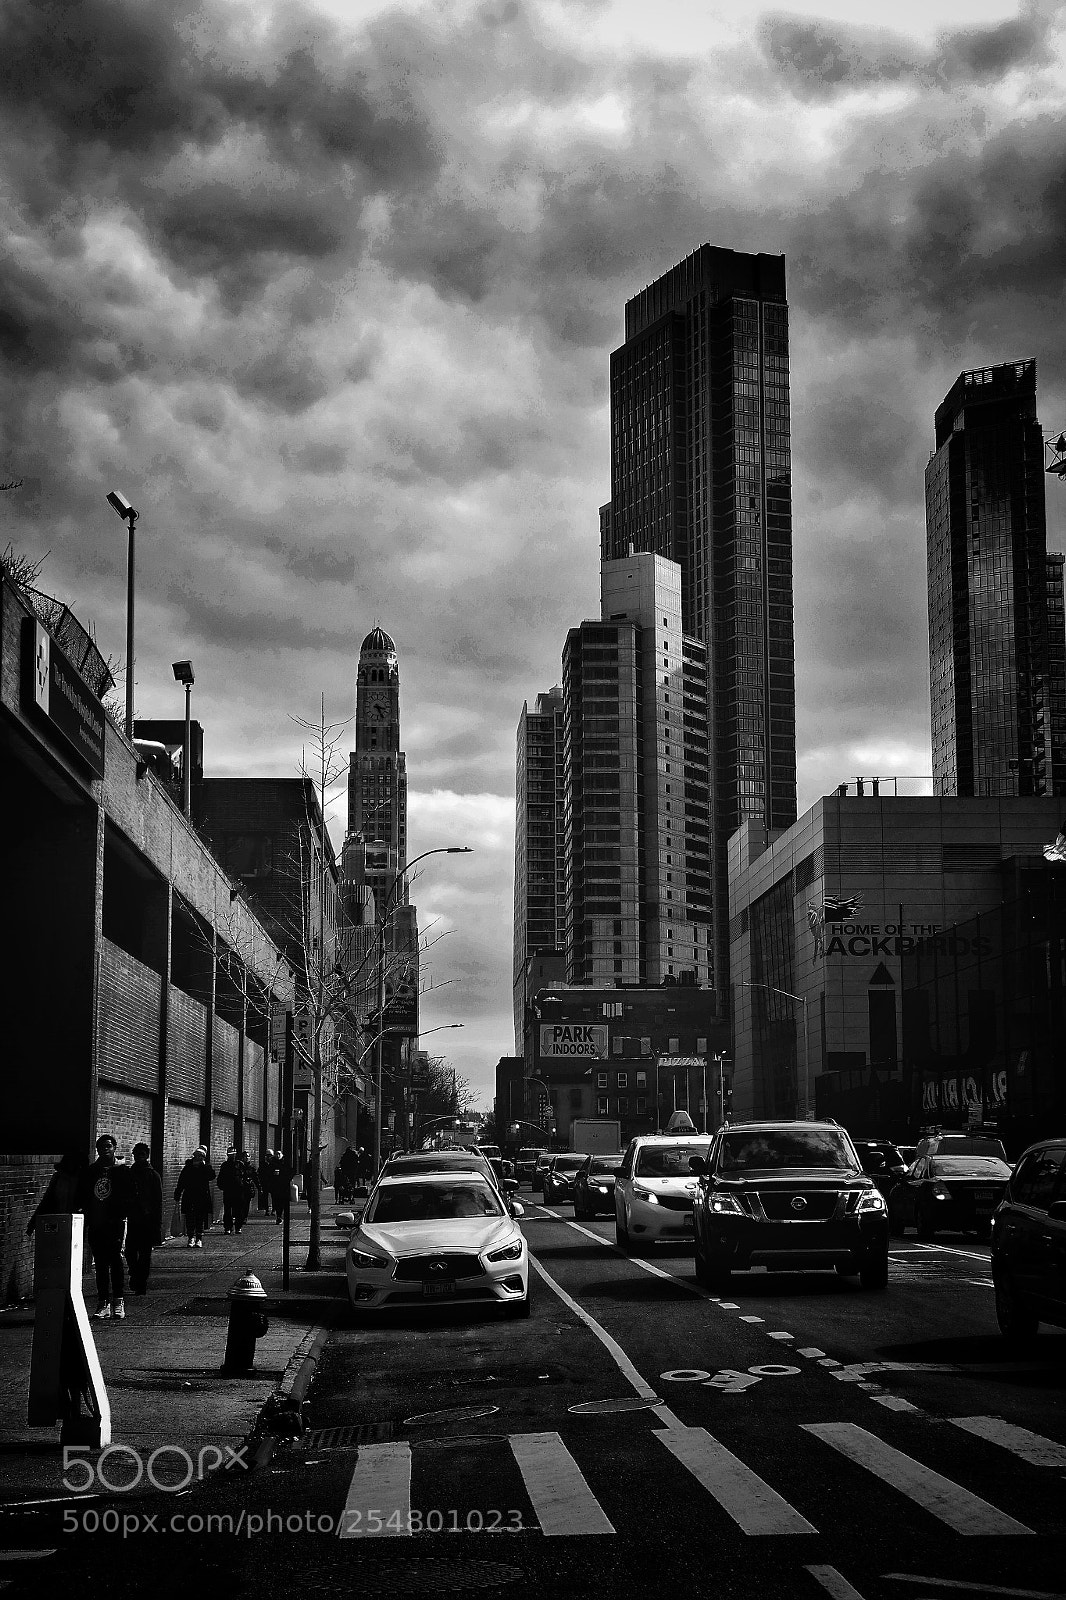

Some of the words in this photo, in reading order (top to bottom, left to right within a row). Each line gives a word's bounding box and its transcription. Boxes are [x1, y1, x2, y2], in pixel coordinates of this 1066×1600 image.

[831, 924, 880, 935] HOME
[884, 924, 908, 935] OF
[910, 924, 942, 935] THE
[553, 1026, 595, 1043] PARK
[552, 1043, 595, 1055] INDOORS
